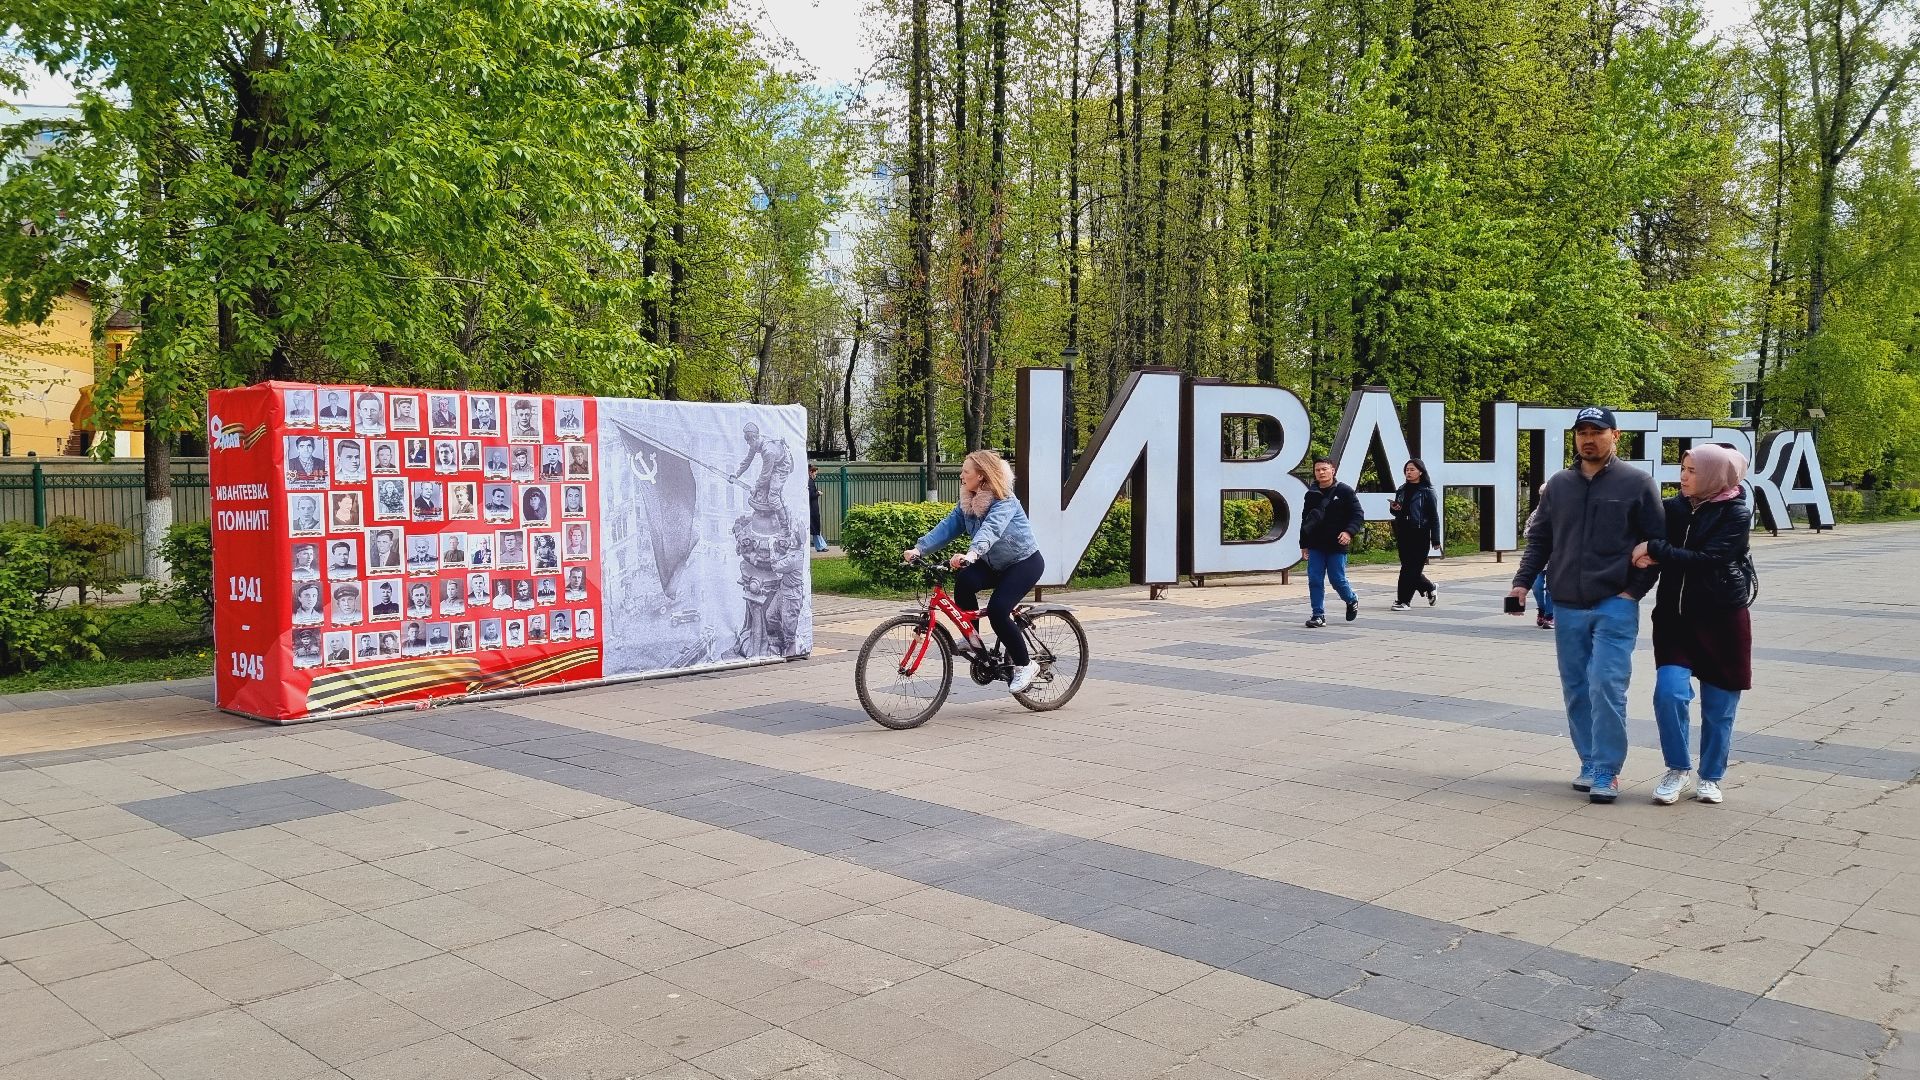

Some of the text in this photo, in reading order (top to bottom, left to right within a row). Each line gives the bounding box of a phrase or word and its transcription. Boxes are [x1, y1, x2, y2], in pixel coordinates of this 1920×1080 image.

[215, 483, 269, 501] ИВАНТЕЕВКА
[217, 510, 270, 531] ПОМНИТ!
[229, 576, 263, 603] 1941
[939, 598, 971, 630] STELS
[231, 652, 265, 681] 1945
